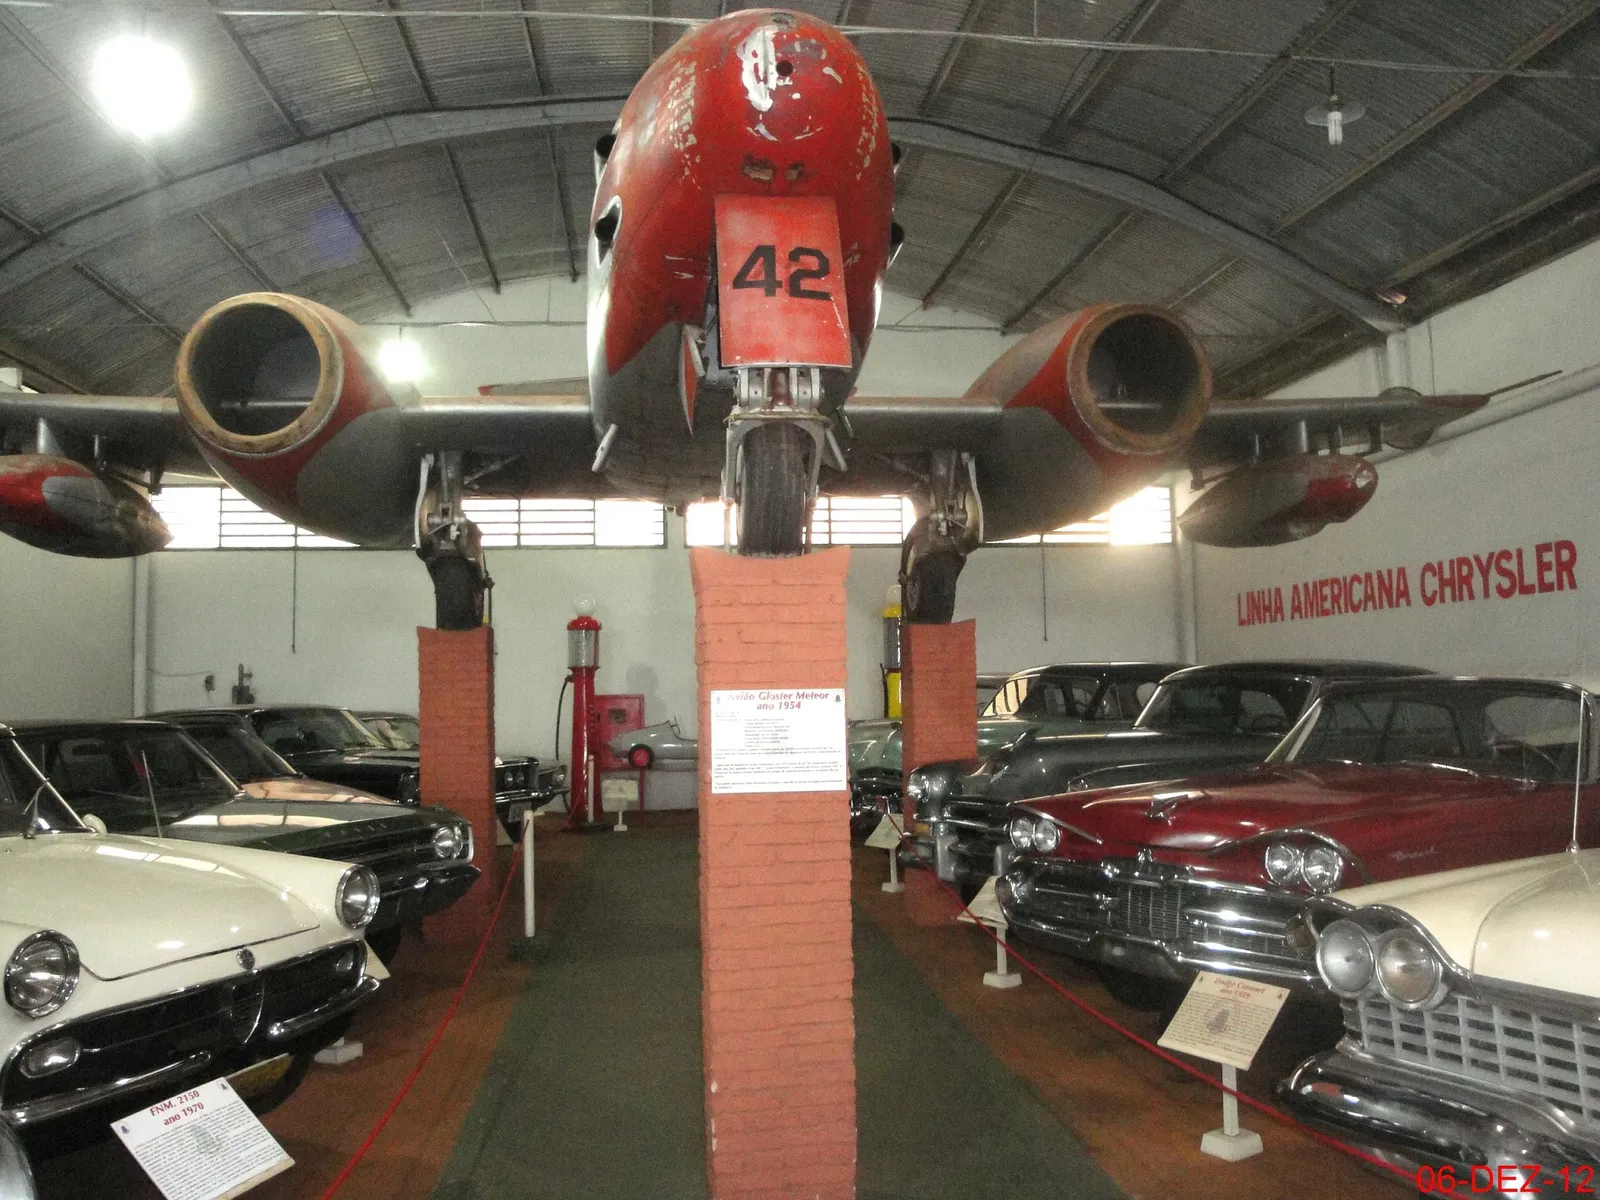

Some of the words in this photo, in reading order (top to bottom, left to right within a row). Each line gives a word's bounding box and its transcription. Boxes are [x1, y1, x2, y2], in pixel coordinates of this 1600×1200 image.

[733, 244, 832, 302] 42
[1237, 586, 1285, 627] LINHA
[1290, 566, 1412, 621] AMERICANA
[1420, 539, 1578, 607] CHRYSLER
[756, 702, 775, 710] ano
[778, 700, 802, 710] 1954
[758, 691, 793, 701] Gloster
[795, 691, 829, 700] Meteor
[149, 1103, 177, 1117] FNM.
[178, 1090, 200, 1104] 2150
[163, 1114, 181, 1126] ano
[182, 1102, 205, 1118] 1970
